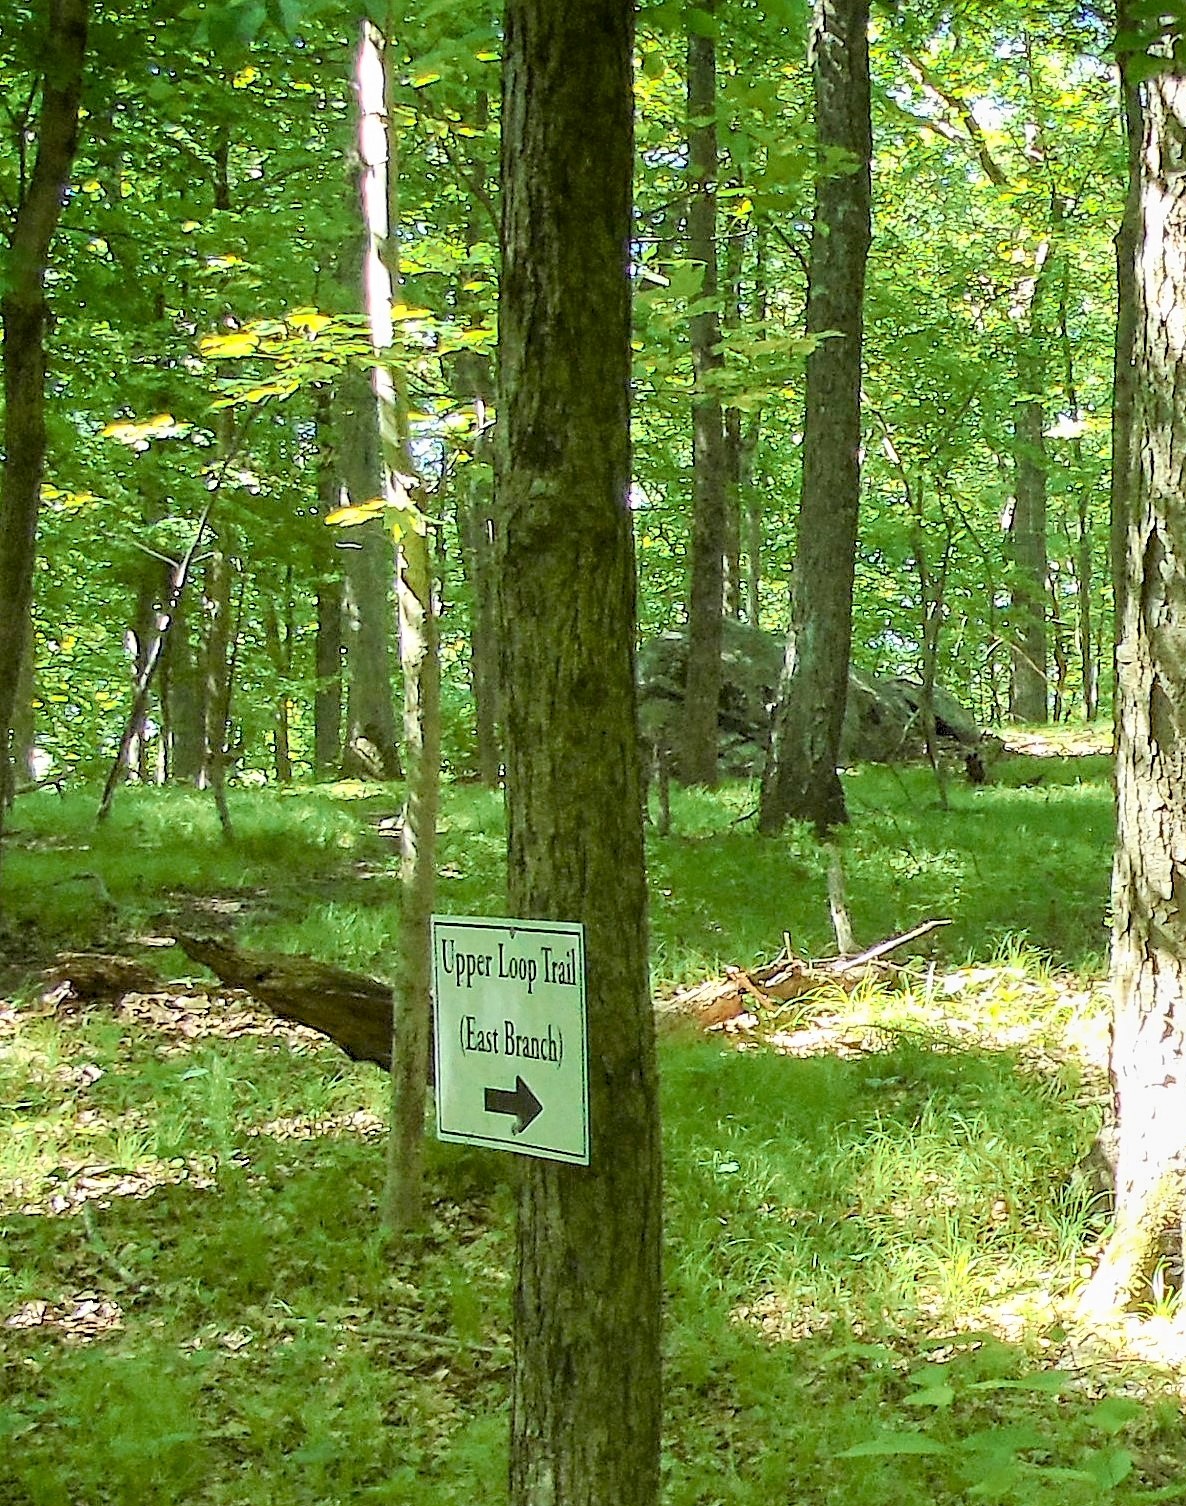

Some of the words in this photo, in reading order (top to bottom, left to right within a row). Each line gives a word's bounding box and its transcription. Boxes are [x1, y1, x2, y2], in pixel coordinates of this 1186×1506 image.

[442, 939, 493, 988] Upper
[498, 943, 537, 994] Loop
[541, 946, 577, 986] Trail
[460, 1014, 499, 1057] (East
[504, 1020, 563, 1070] Branch)
